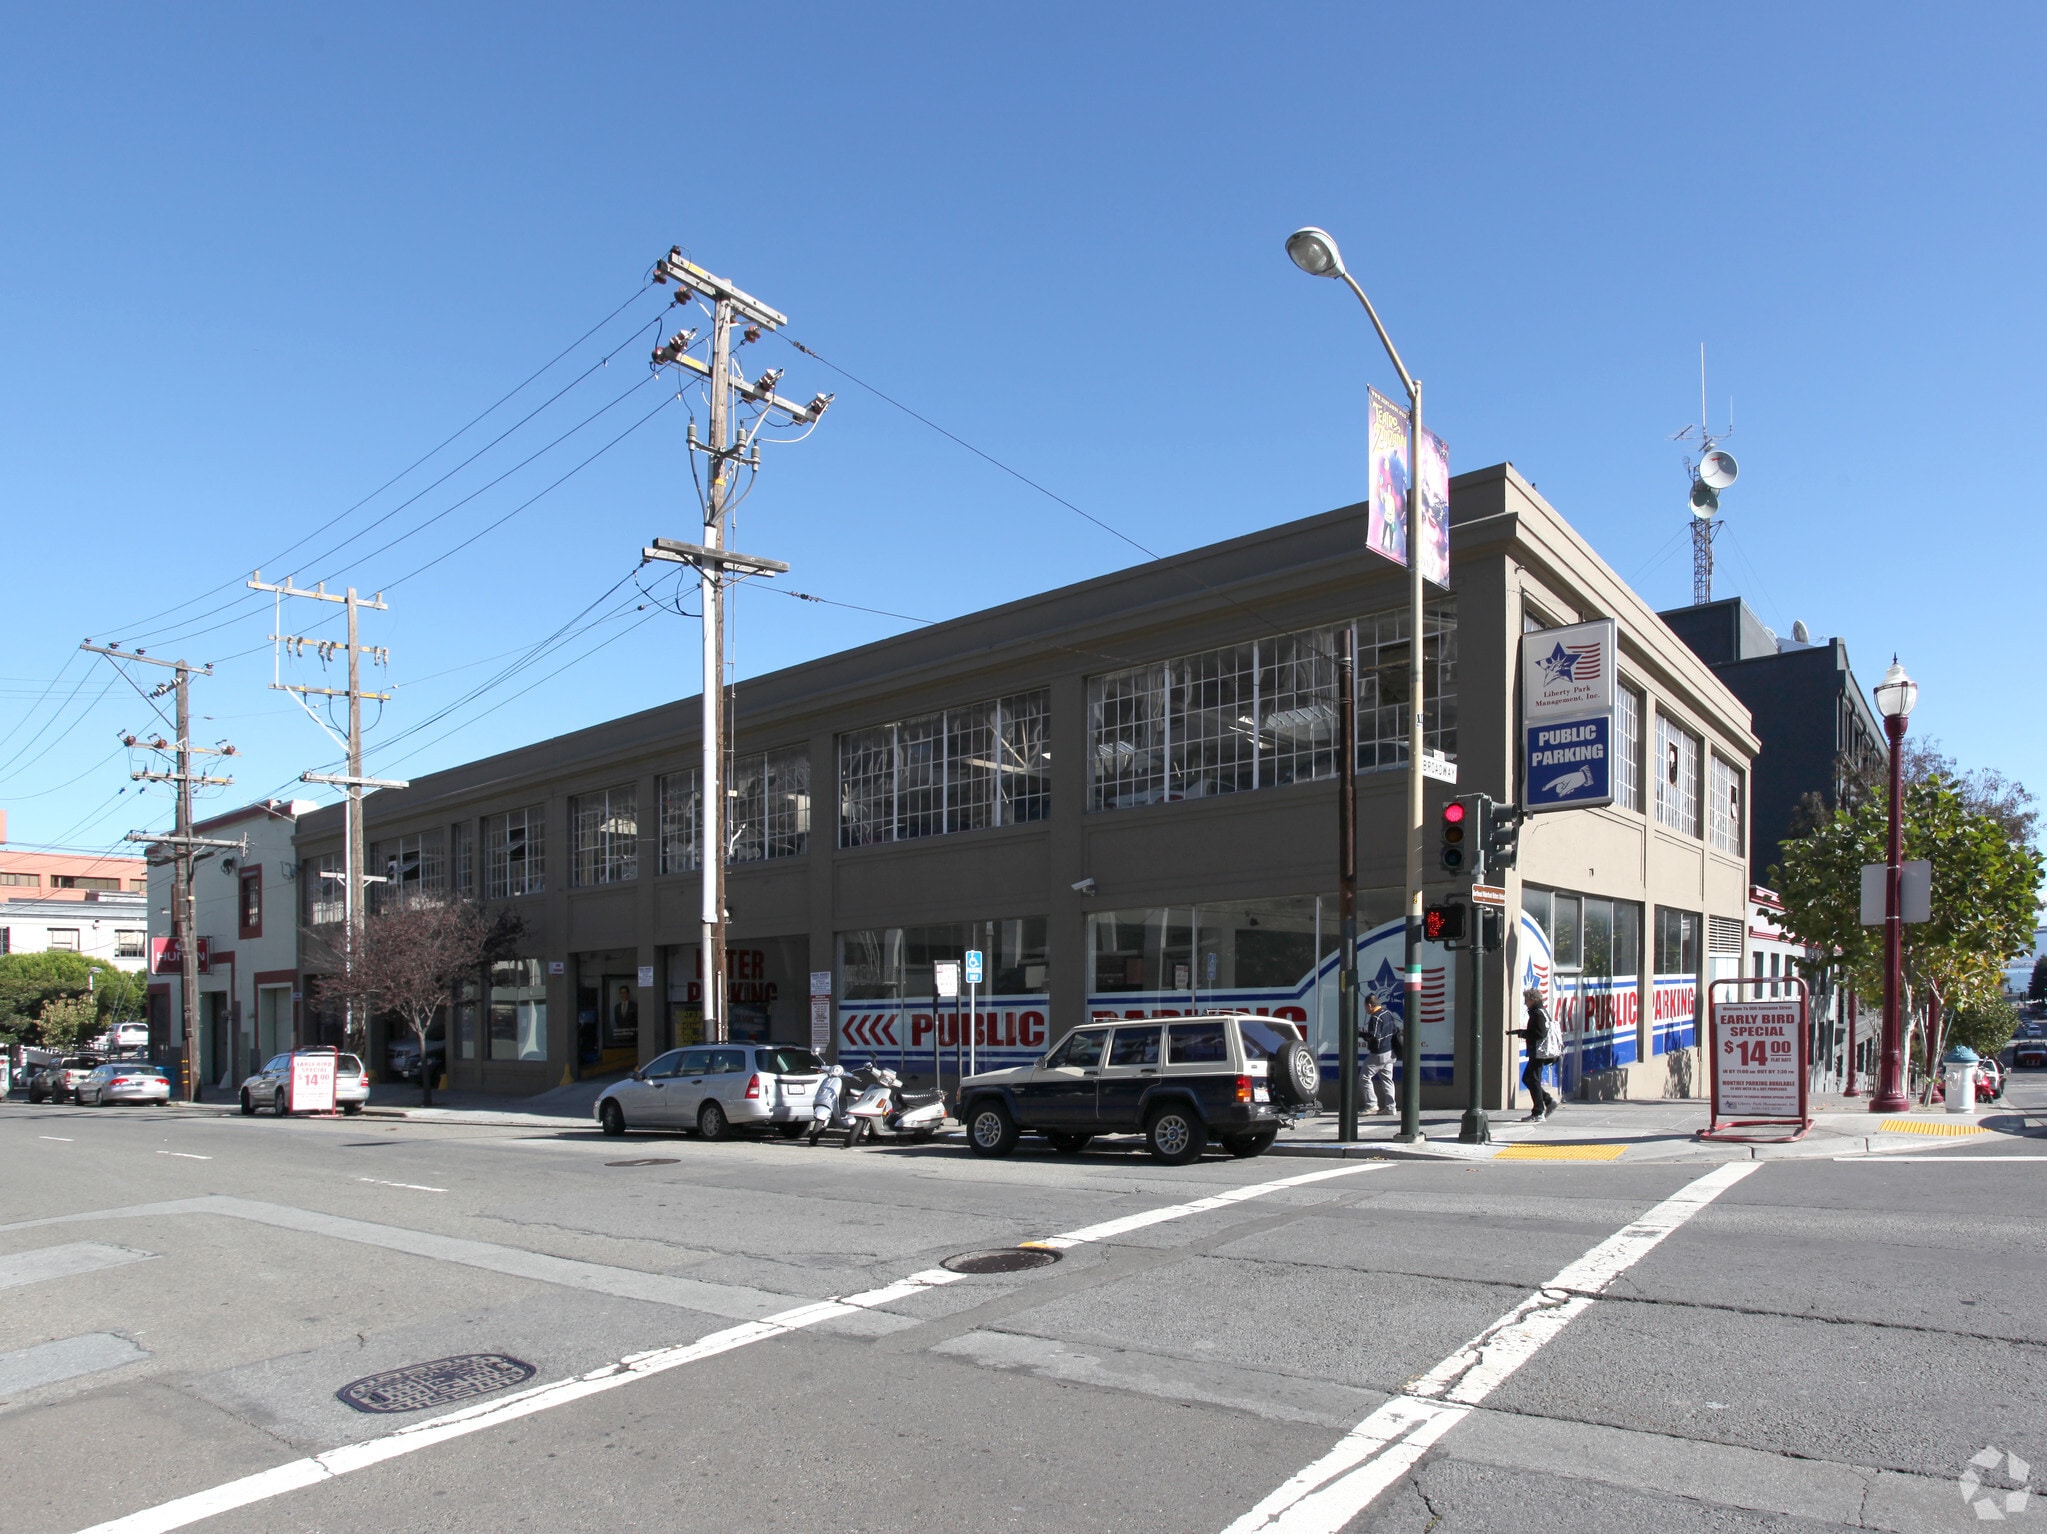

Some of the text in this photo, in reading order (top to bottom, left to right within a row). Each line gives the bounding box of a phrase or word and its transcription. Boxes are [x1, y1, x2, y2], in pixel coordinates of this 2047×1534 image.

[1544, 685, 1591, 698] Liberty Park
[1536, 696, 1584, 707] Management,
[1538, 725, 1597, 747] PUBLIC
[1531, 744, 1604, 767] PARKING
[1423, 760, 1455, 778] BROADWAY
[1584, 992, 1637, 1032] PUBLIC
[1720, 1014, 1795, 1024] EARLY BIRD
[911, 1010, 1045, 1047] PUBLIC
[1730, 1026, 1785, 1036] SPECIAL
